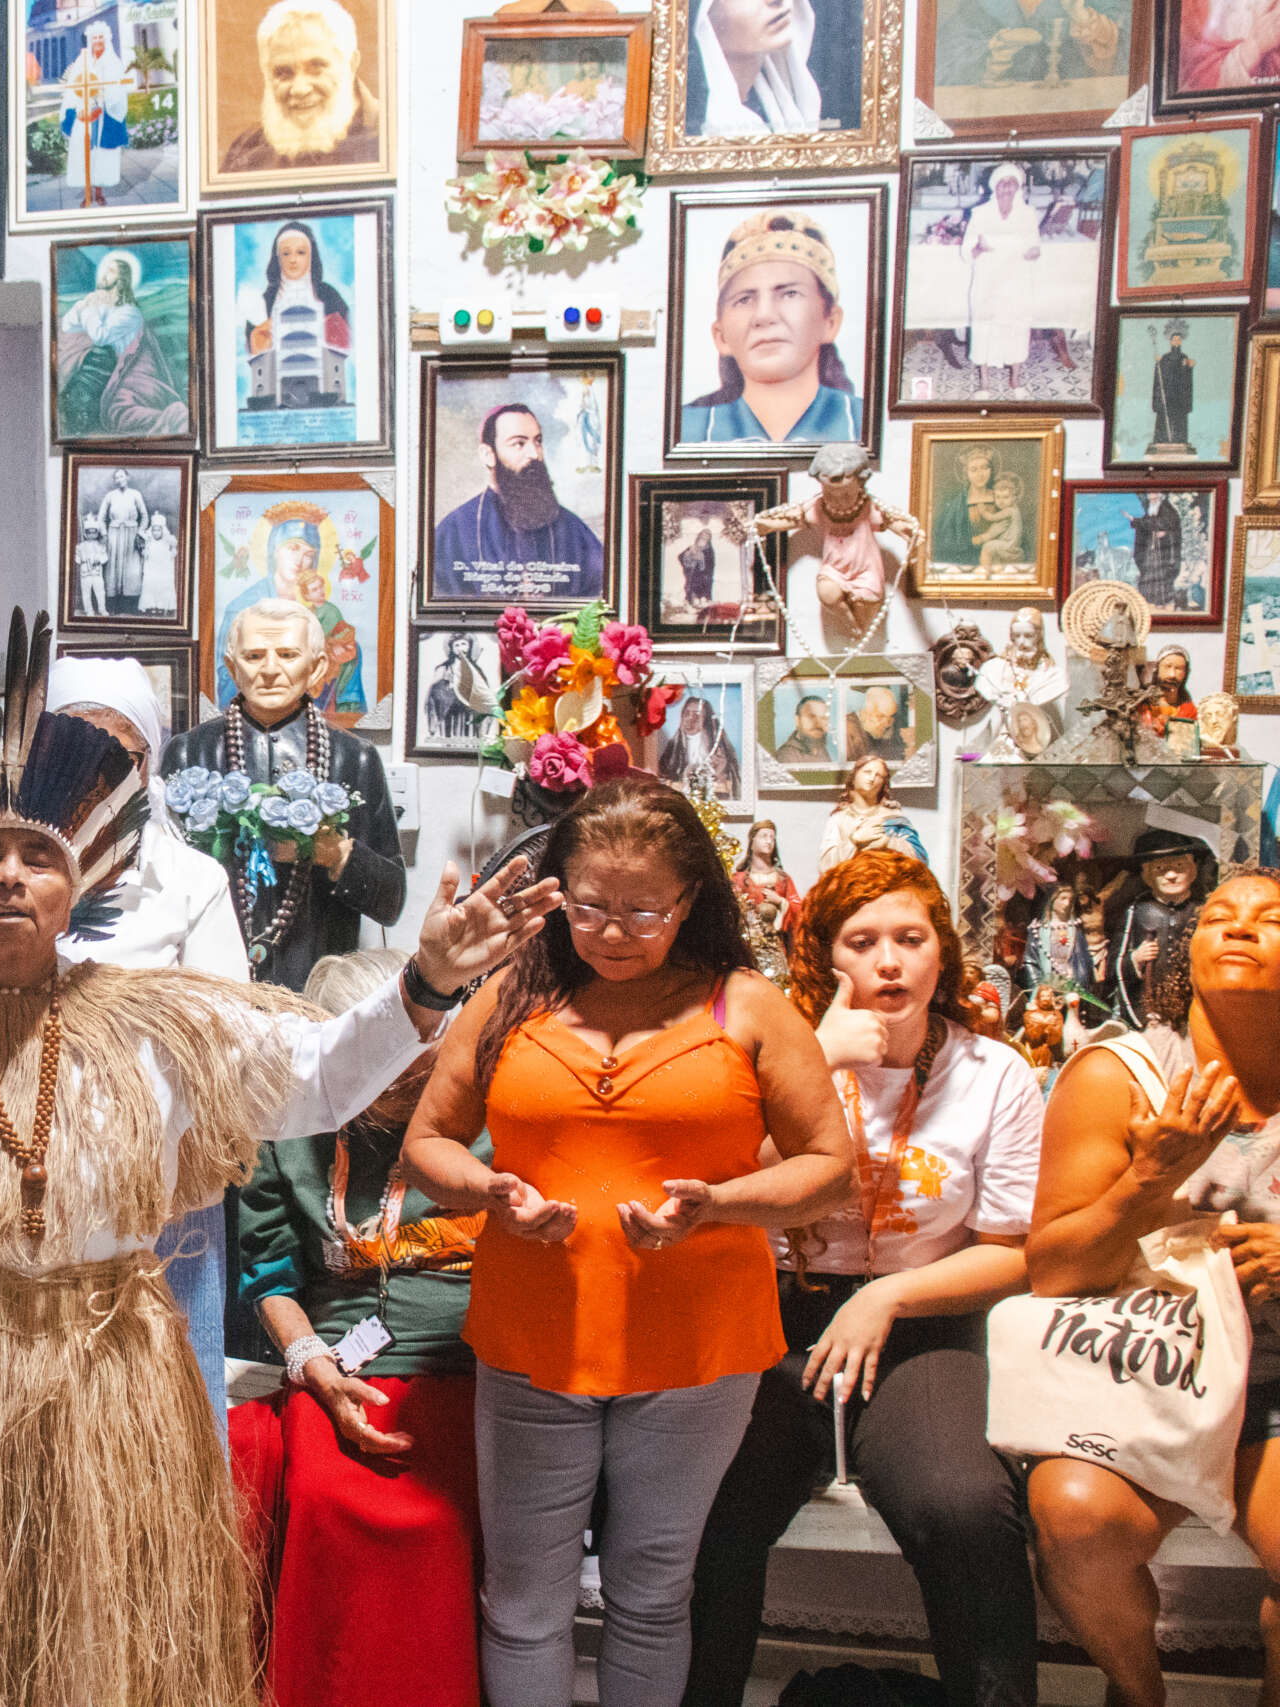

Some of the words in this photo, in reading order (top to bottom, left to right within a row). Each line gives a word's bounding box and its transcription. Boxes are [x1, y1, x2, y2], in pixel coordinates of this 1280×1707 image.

[151, 93, 174, 110] 14
[453, 561, 469, 571] D.
[472, 561, 504, 571] Vital
[506, 561, 524, 571] de
[526, 561, 581, 572] Oliveira
[463, 572, 502, 583] Bispo
[504, 572, 522, 582] de
[523, 572, 570, 582] Olinda
